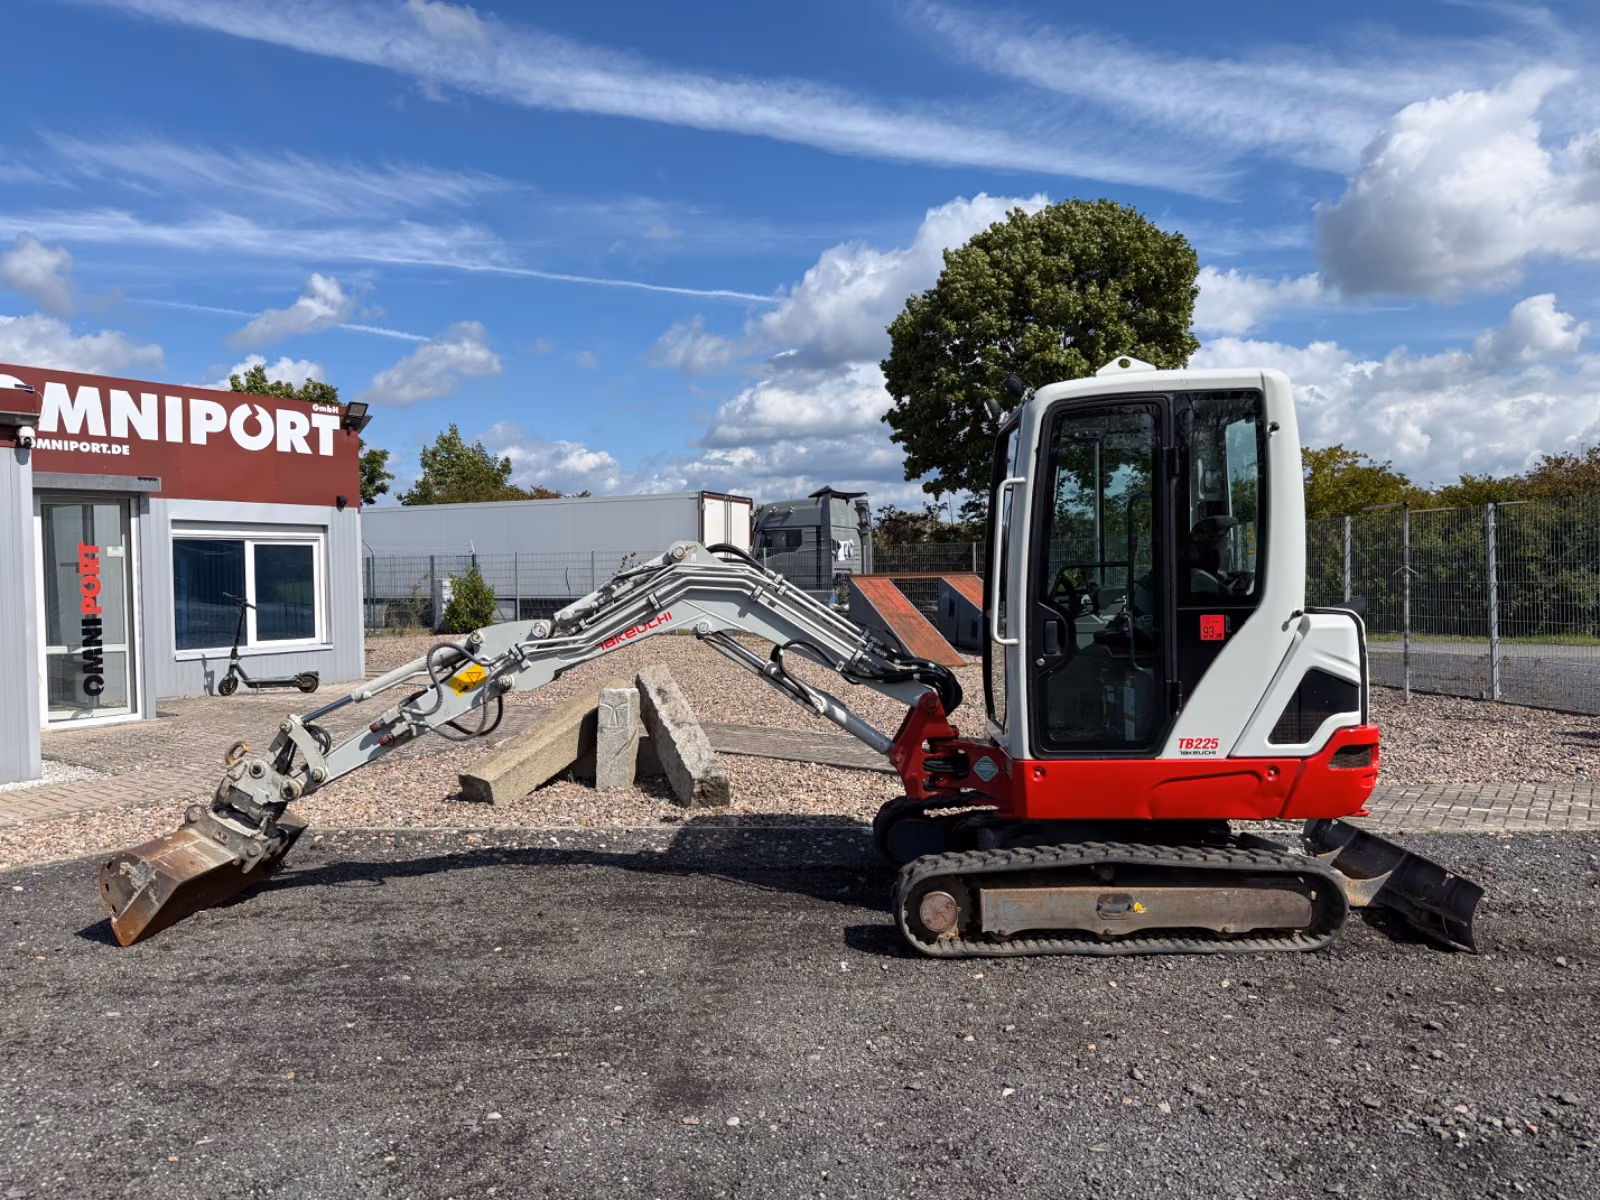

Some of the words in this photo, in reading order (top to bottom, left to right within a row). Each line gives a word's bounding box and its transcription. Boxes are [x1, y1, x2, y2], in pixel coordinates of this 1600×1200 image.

[312, 403, 339, 414] GmbH
[1202, 625, 1215, 639] 93
[1178, 738, 1219, 750] TB225
